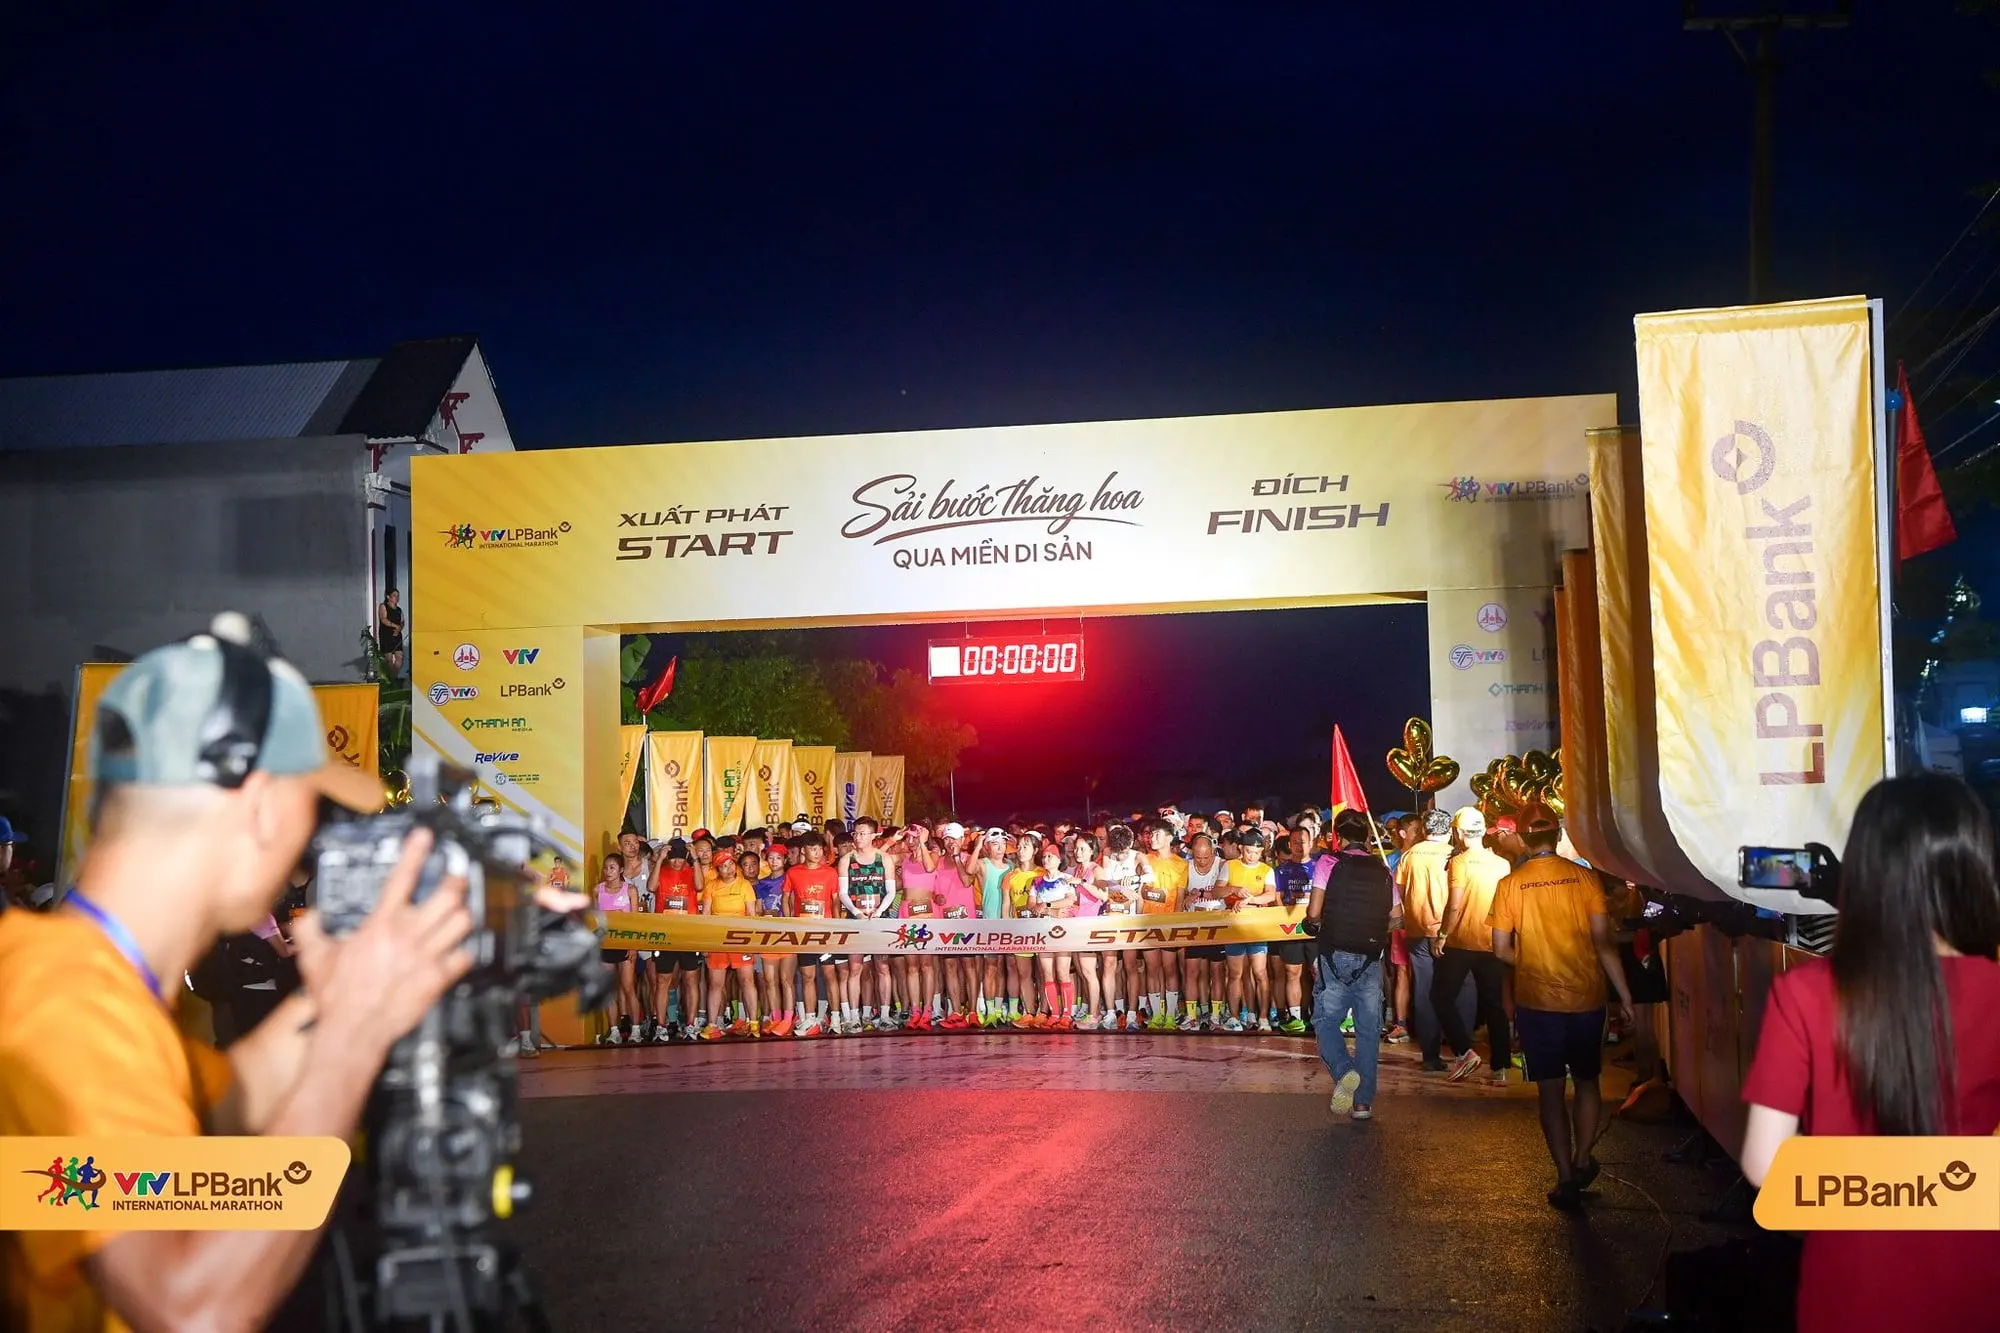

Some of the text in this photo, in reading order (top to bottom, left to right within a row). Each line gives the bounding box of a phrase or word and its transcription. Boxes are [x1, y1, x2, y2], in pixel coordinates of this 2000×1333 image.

[1251, 473, 1349, 496] ĐÍCH
[1485, 480, 1575, 495] VTV LPBank
[617, 503, 790, 527] XUẤT PHÁT
[841, 474, 926, 538] Sải
[928, 479, 997, 520] bước
[1090, 471, 1145, 511] hoa
[1207, 502, 1390, 535] FINISH
[480, 528, 559, 541] VTV LPBank
[616, 530, 794, 561] START
[893, 535, 1092, 569] QUA MIỀN DI SẢN
[1746, 494, 1827, 786] LPBank
[502, 648, 540, 665] VTV
[963, 643, 1078, 676] 00:00:00
[450, 687, 477, 697] VTV6
[500, 684, 552, 697] LPBank
[475, 752, 519, 763] ReVive
[672, 779, 688, 838] PBank
[766, 782, 780, 834] PBank
[844, 782, 856, 832] eVive
[881, 791, 893, 827] Bank
[1519, 878, 1580, 891] ORGANIZER
[723, 930, 860, 946] START
[939, 932, 1046, 946] VTV LPBank
[1087, 925, 1229, 945] START
[1280, 922, 1303, 935] VT
